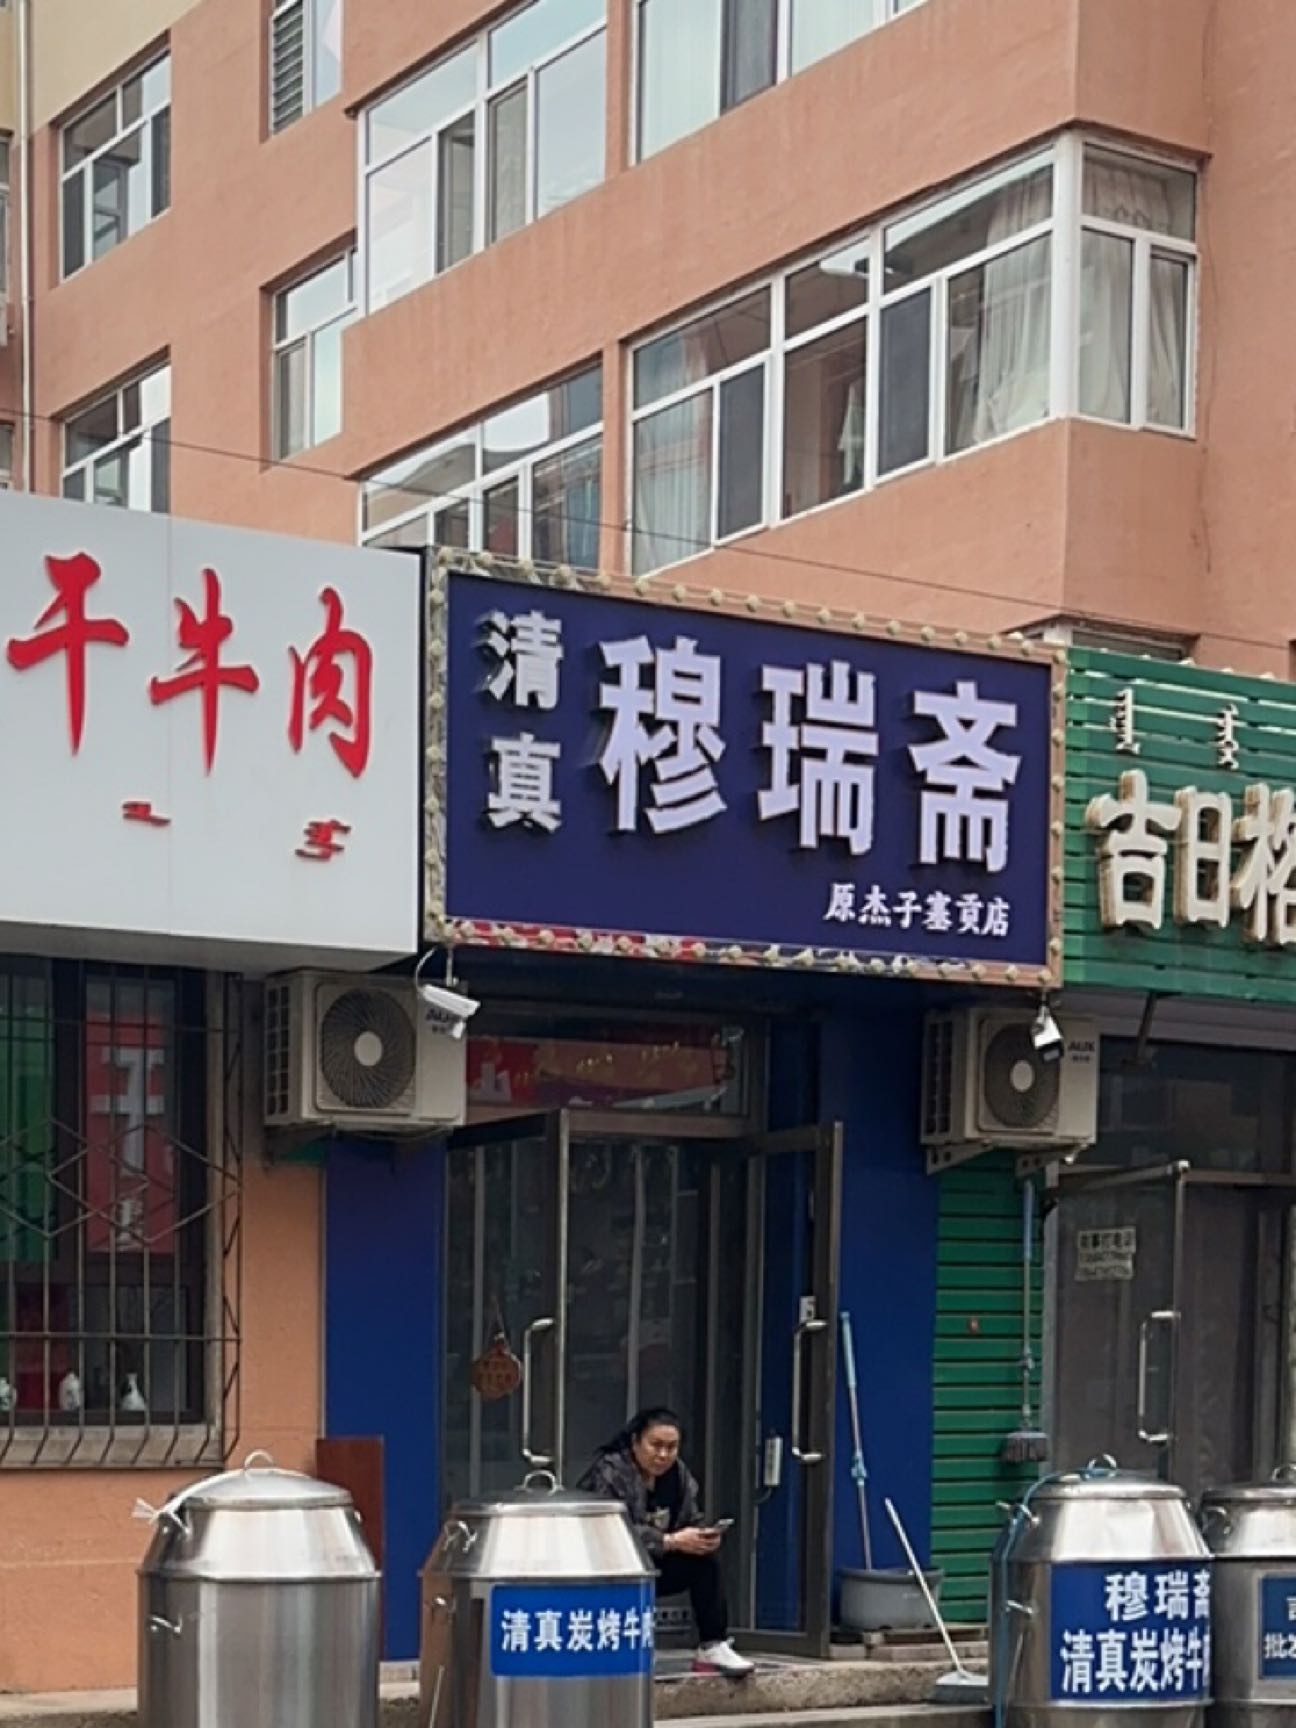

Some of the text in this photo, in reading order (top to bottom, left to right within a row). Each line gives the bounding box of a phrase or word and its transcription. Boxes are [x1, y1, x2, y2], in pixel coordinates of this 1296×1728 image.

[488, 610, 565, 832] 清真
[599, 635, 1022, 873] 穆瑞斋
[1060, 1627, 1210, 1693] 清真炭烤牛
